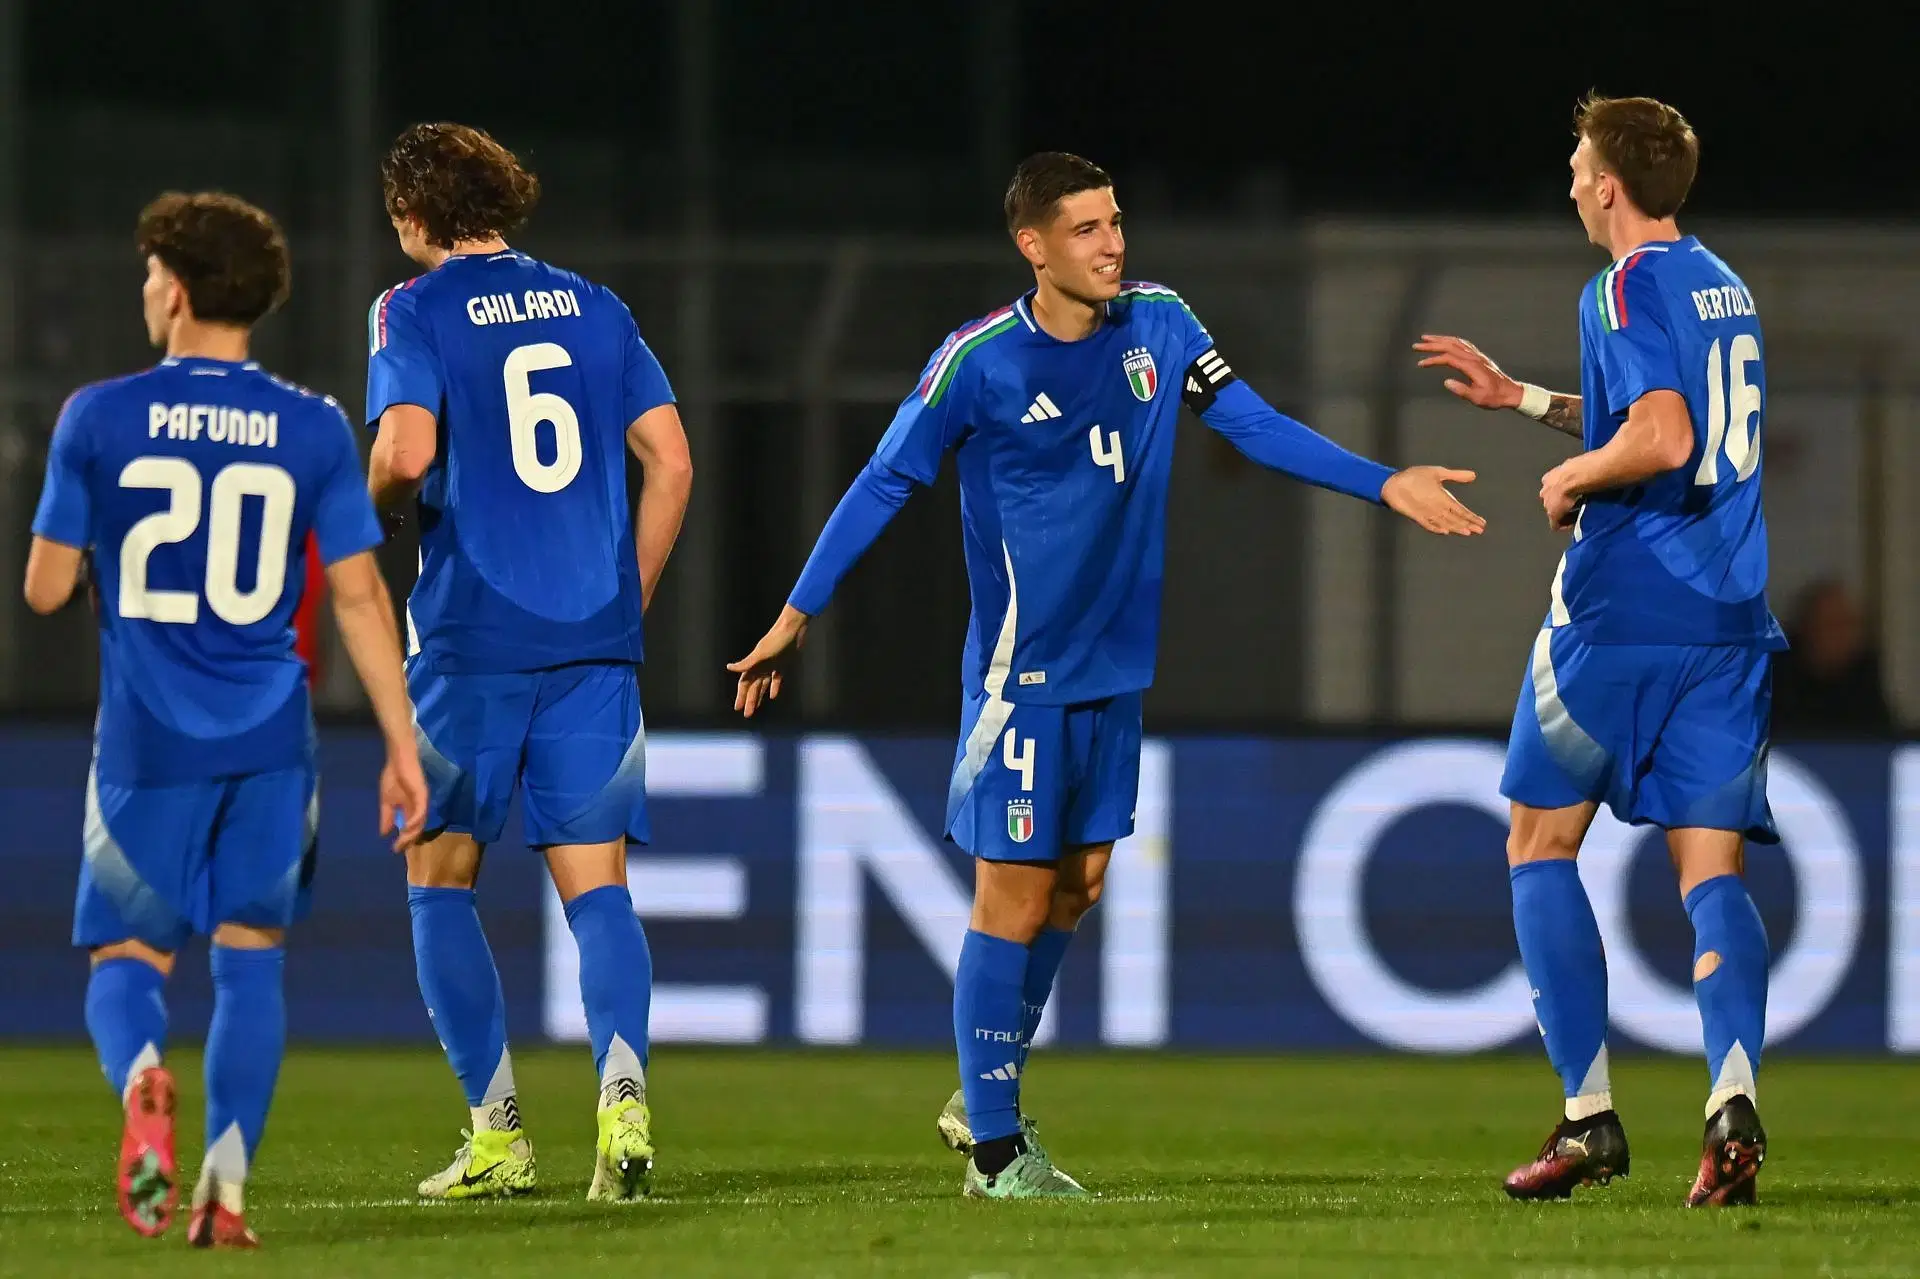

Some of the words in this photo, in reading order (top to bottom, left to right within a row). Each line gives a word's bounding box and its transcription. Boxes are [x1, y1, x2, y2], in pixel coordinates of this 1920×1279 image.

[466, 289, 582, 326] GHILARDI
[1126, 357, 1151, 372] ITALIA
[148, 402, 279, 448] PAFUNDI
[503, 343, 582, 493] 6
[1694, 334, 1761, 486] 16
[1089, 424, 1125, 484] 4
[118, 456, 296, 625] 20
[1003, 728, 1035, 791] 4
[1009, 807, 1031, 816] ITALIA
[1293, 739, 1920, 1053] CO
